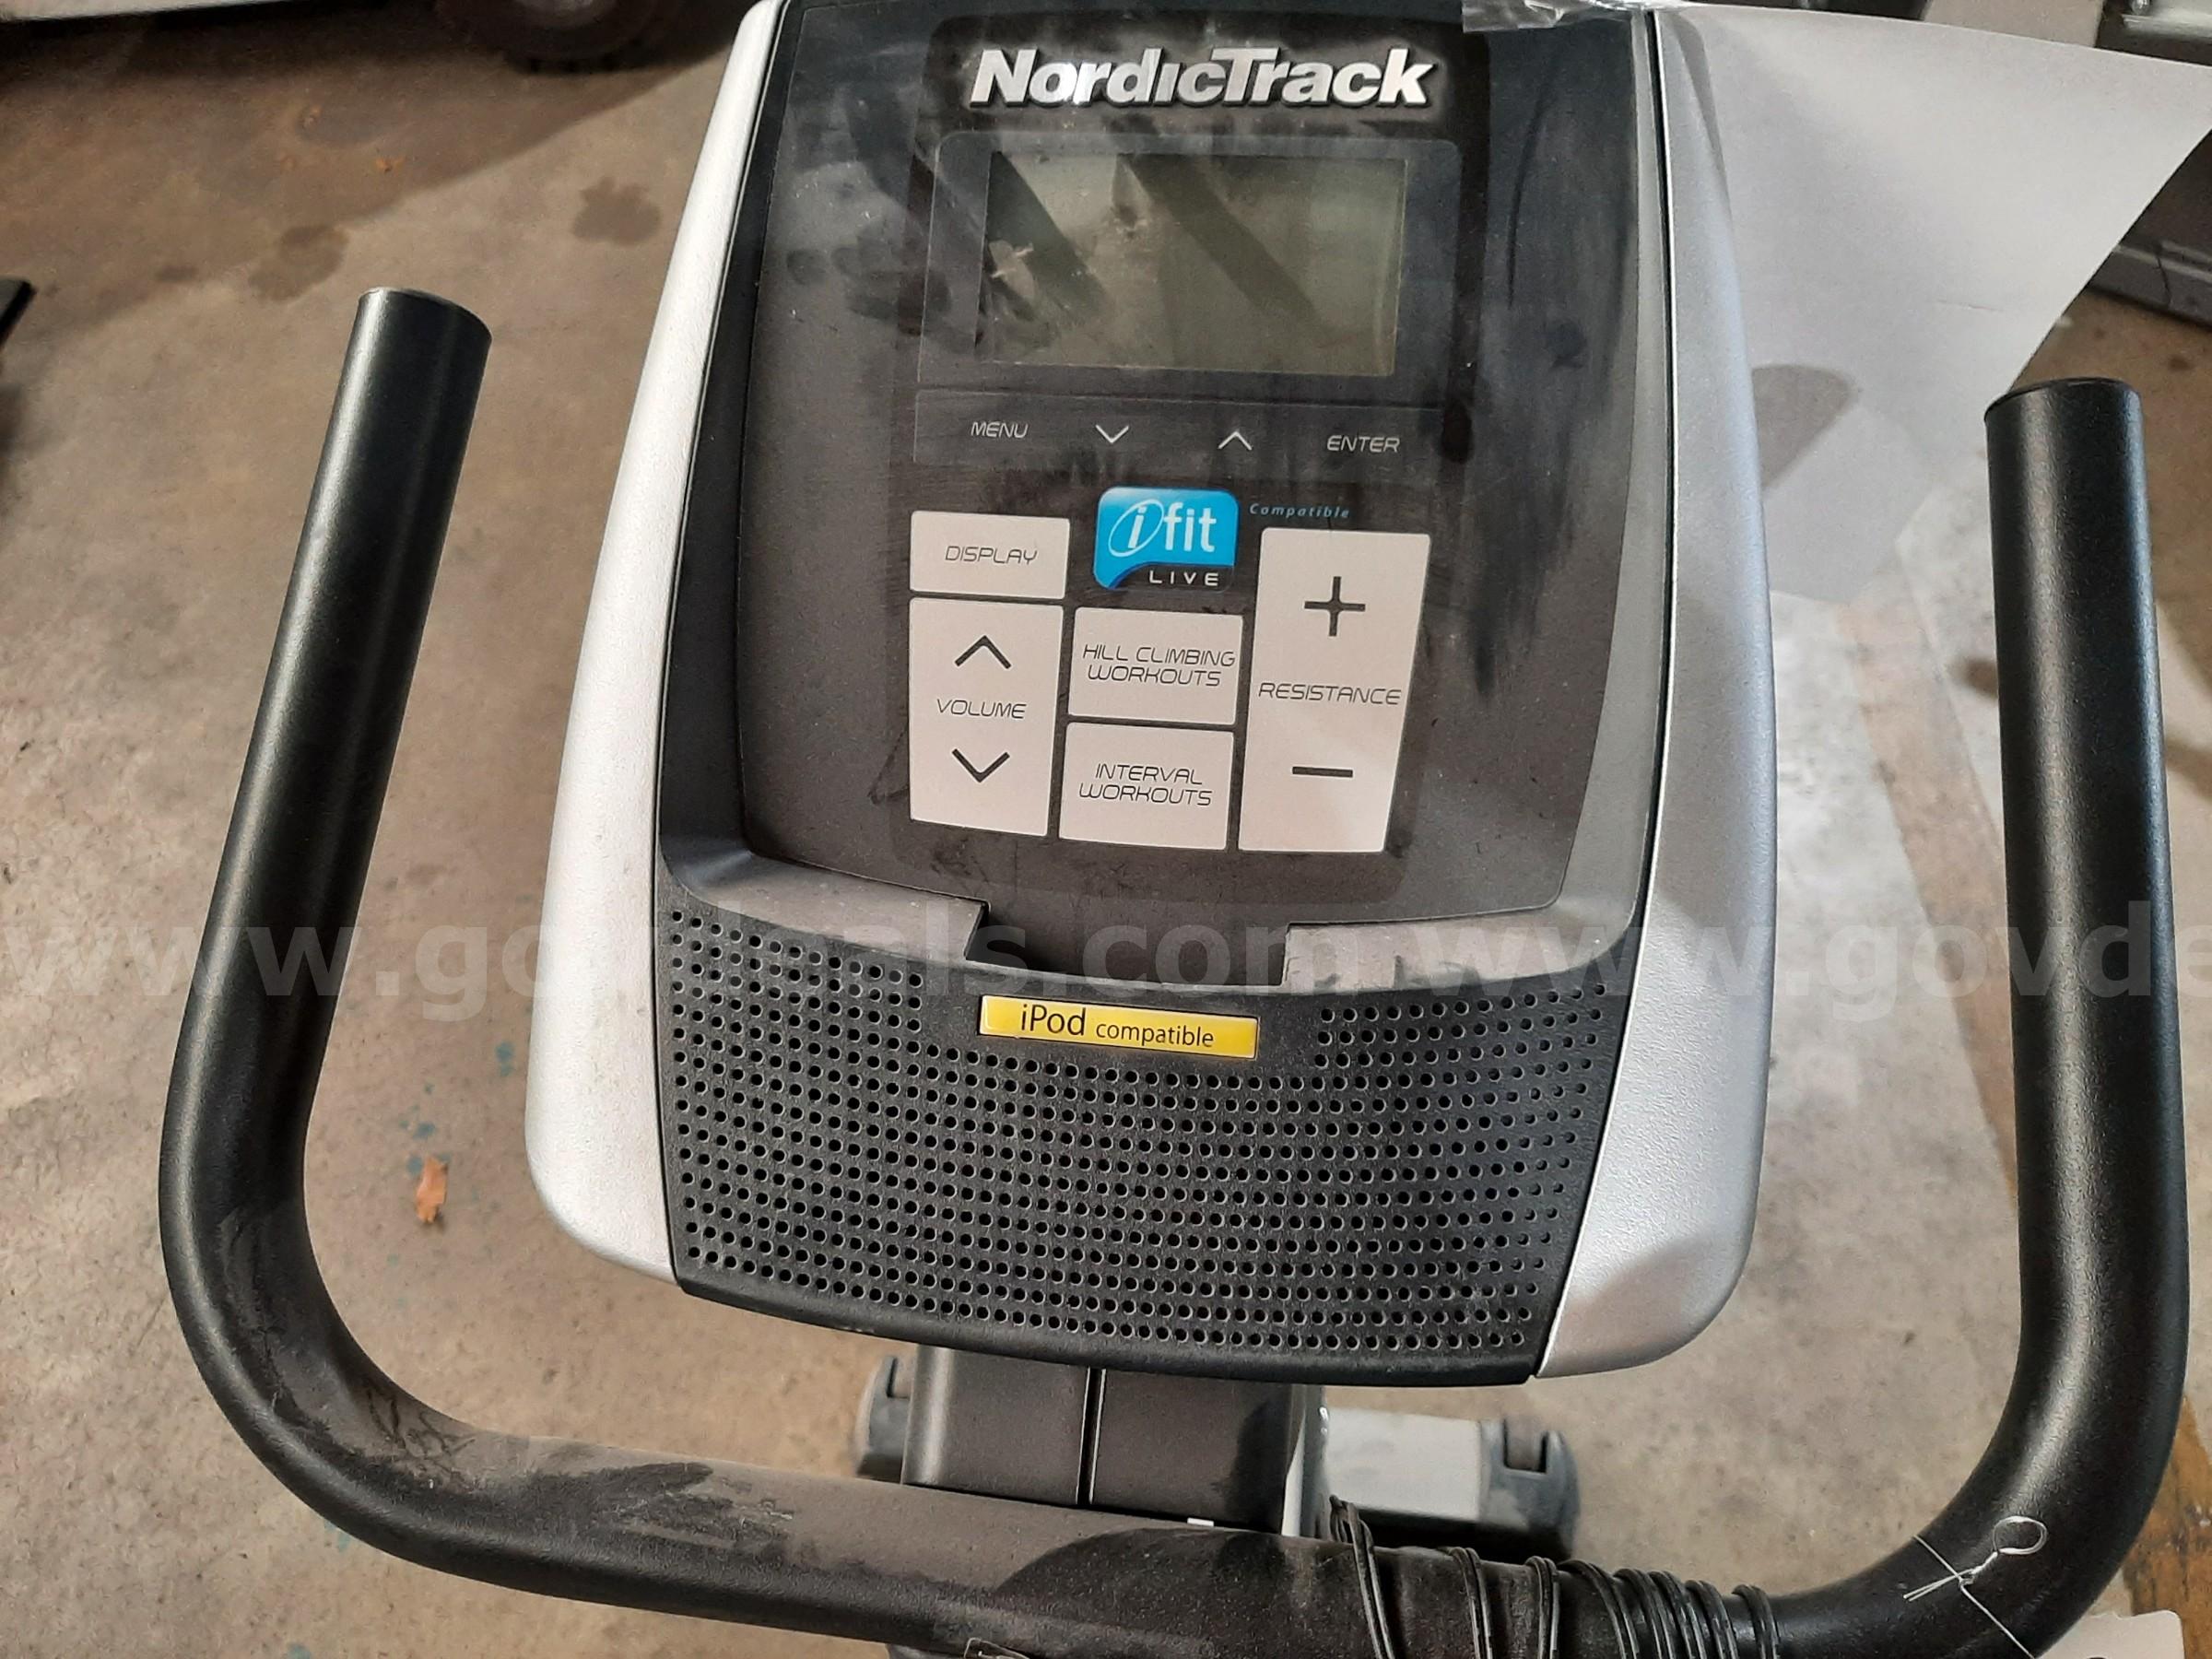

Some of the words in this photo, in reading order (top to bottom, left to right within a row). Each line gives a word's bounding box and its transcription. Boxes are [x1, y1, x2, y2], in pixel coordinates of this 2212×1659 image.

[970, 47, 1438, 109] NordicTrack
[971, 421, 1028, 439] MENU
[1326, 434, 1401, 453] ENTER
[1249, 502, 1350, 520] Compatible
[945, 546, 1038, 566] DISPLAY
[1149, 570, 1219, 587] LIVE
[1082, 644, 1129, 663] HILL
[1135, 646, 1236, 668] CLIMBING
[1088, 665, 1221, 688] WORKOUTS
[1258, 682, 1402, 706] RESISTANCE
[936, 698, 1027, 720] VOLUME
[1096, 763, 1203, 786] INTERVAL
[1078, 783, 1213, 807] WORKOUTS
[1021, 1003, 1087, 1036] iPod
[1096, 1021, 1215, 1048] compatible
